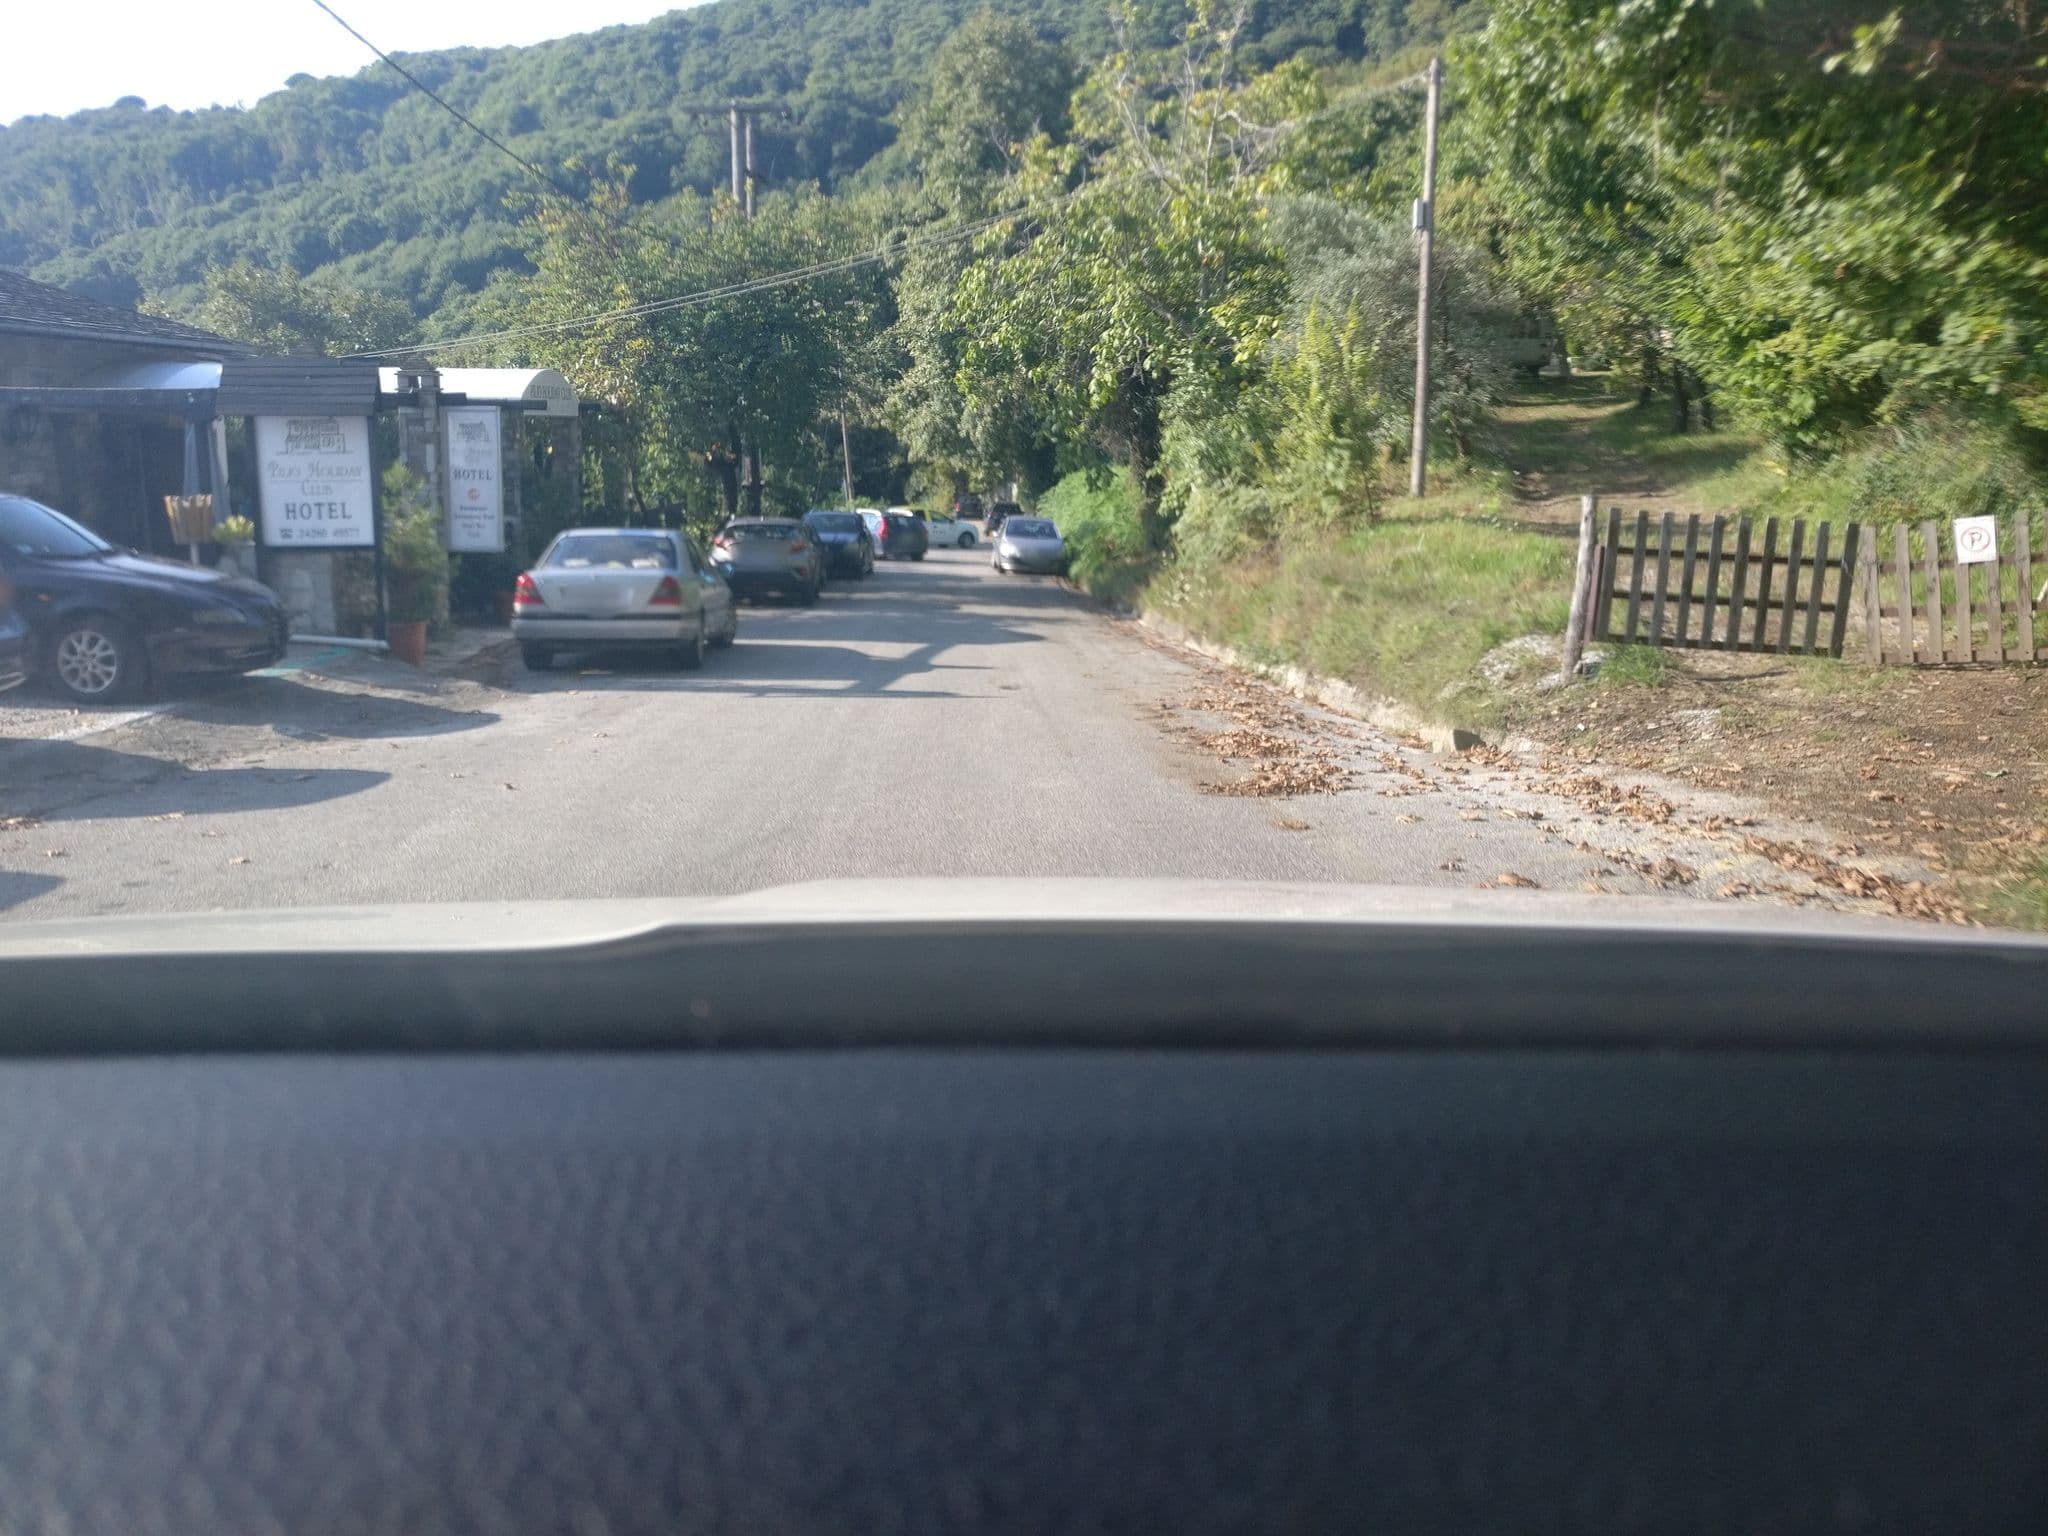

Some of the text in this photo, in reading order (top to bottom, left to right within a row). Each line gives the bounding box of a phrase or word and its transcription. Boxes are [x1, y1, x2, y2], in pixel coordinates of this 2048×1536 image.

[454, 469, 492, 480] HOTEL
[285, 502, 352, 520] HOTEL
[1968, 531, 1983, 550] P
